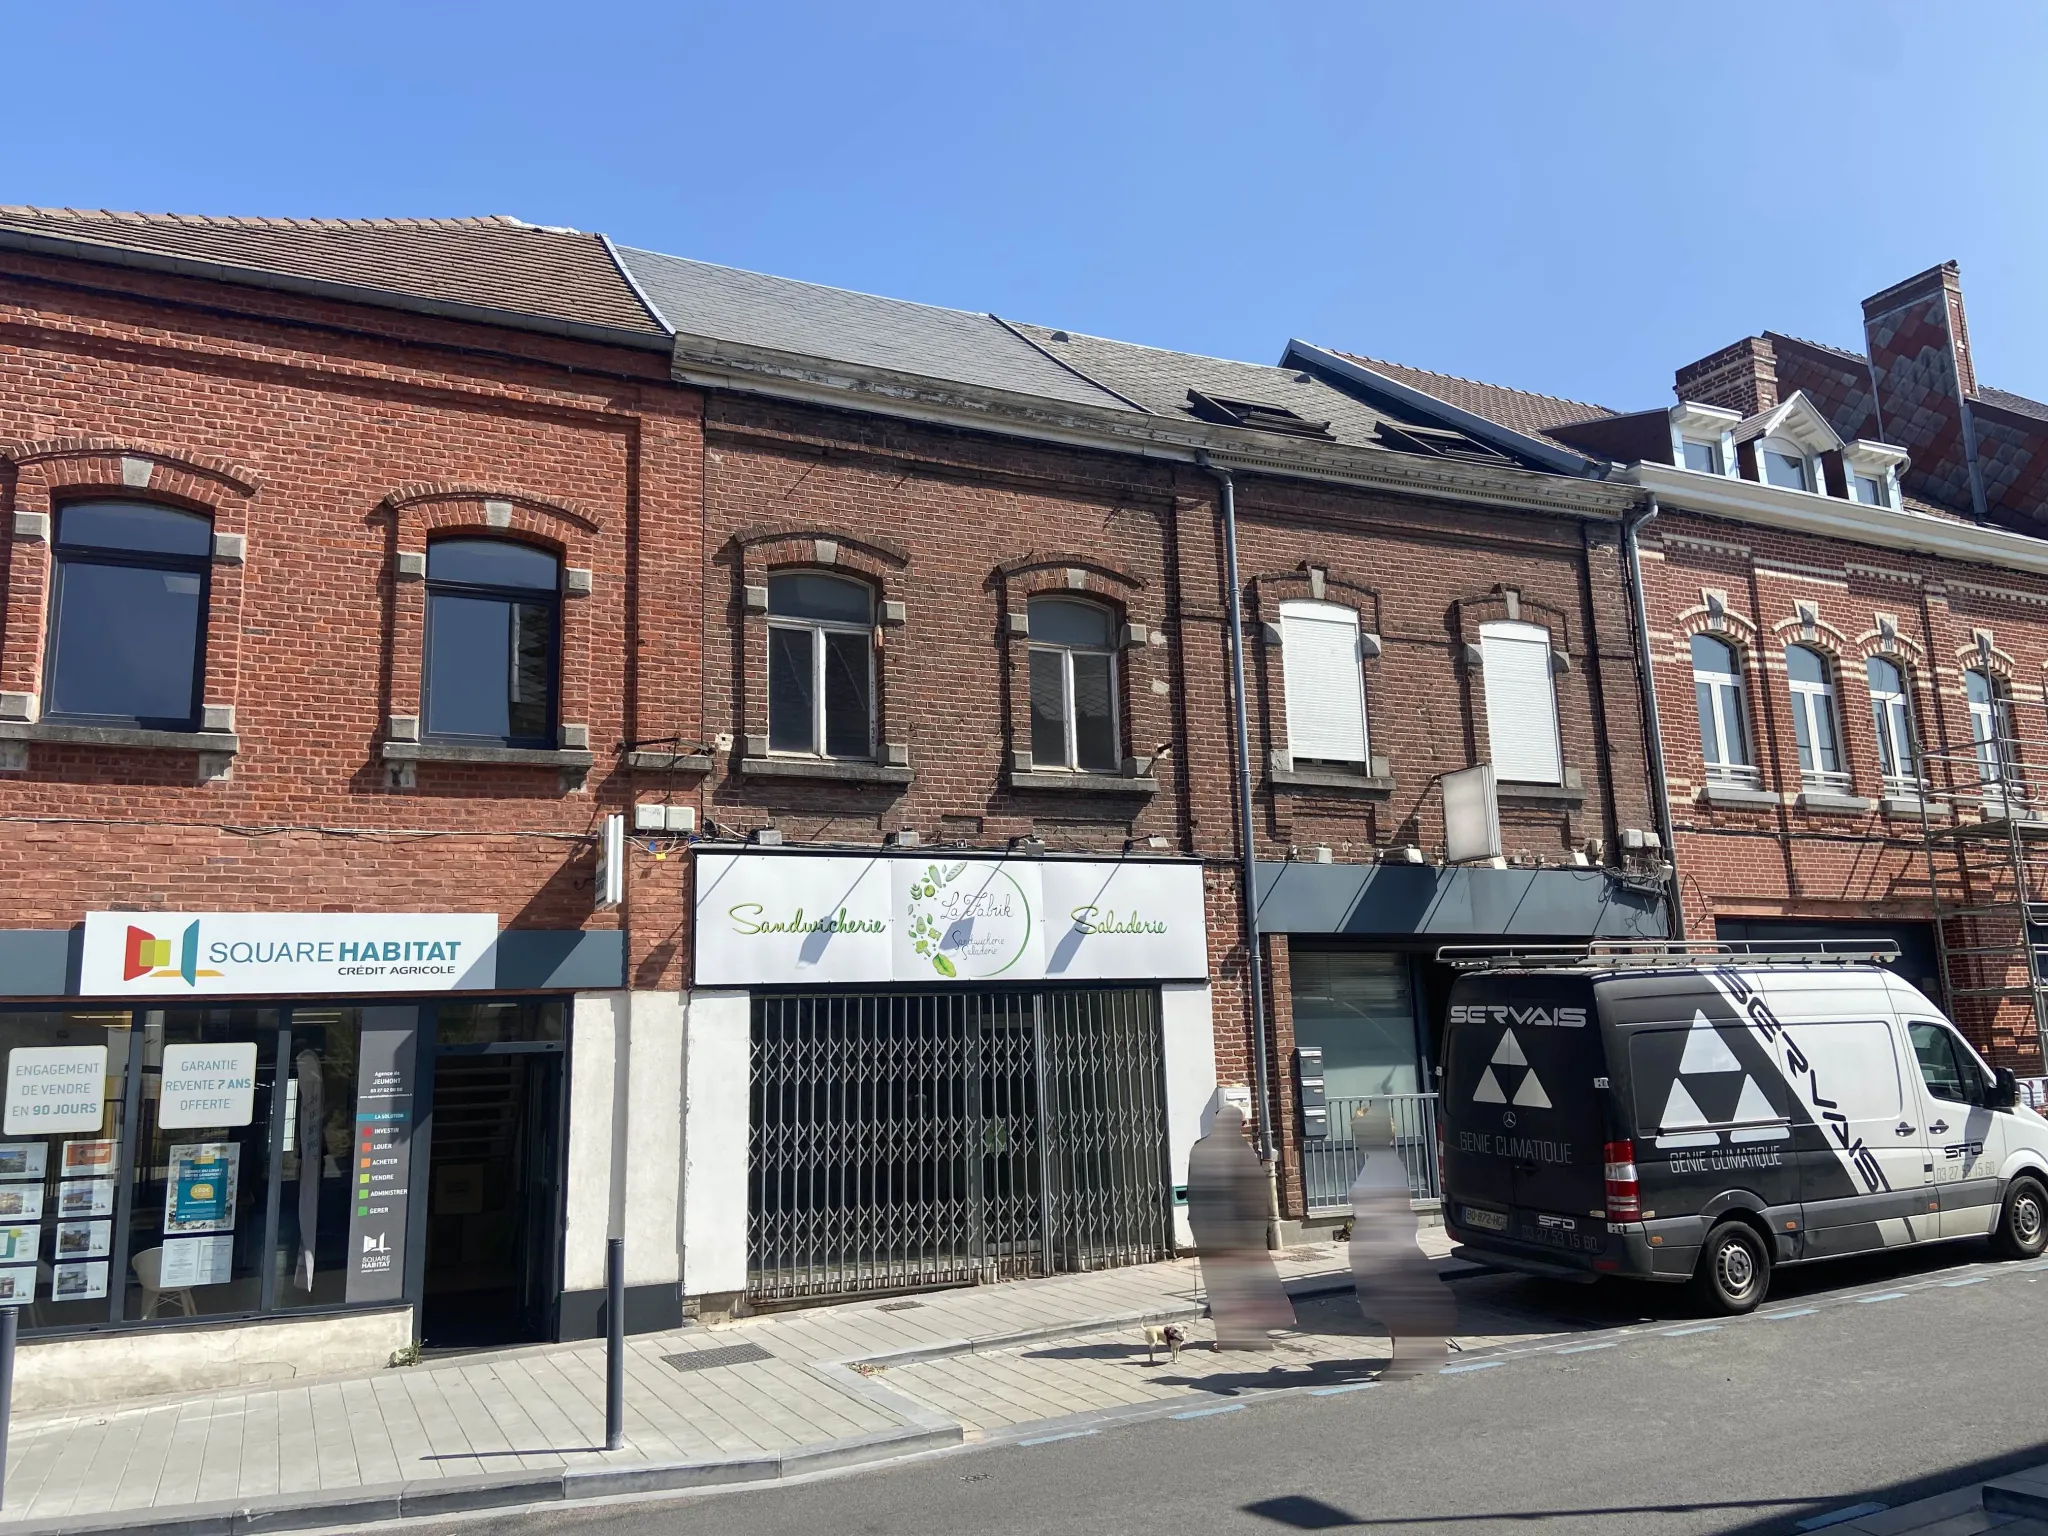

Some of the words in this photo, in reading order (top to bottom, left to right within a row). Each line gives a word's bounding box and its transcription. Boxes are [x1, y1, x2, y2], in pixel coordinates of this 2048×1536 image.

[940, 891, 960, 920] La
[964, 892, 1013, 918] Fabrik
[728, 902, 886, 935] Sandwicherie
[1070, 906, 1167, 935] Saladerie
[952, 930, 1004, 950] Sandwicherie
[961, 944, 998, 960] Saladerie
[338, 965, 386, 976] CRÉDIT
[389, 966, 455, 975] AGRICOLE
[1450, 1005, 1587, 1028] SERVAIS
[16, 1063, 100, 1076] ENGAGEMENT
[181, 1060, 238, 1072] GARANTIE
[165, 1080, 215, 1091] REVENTE
[217, 1079, 225, 1090] 7
[227, 1078, 251, 1089] ANS
[1713, 965, 1893, 1194] SERVAIS
[22, 1085, 38, 1096] DE
[41, 1083, 91, 1095] VENDRE
[12, 1106, 29, 1117] EN
[33, 1104, 50, 1116] 90
[53, 1103, 97, 1115] JOURS
[180, 1099, 231, 1111] OFFERTE
[1460, 1131, 1491, 1154] GENIE
[1495, 1135, 1573, 1164] CLIMATIQUE
[1670, 1150, 1708, 1173] GENIE
[1711, 1145, 1782, 1170] CLIMATIQUE
[1936, 1168, 1947, 1181] 03
[1949, 1166, 1958, 1179] 27
[1975, 1162, 1983, 1176] 15
[1985, 1161, 1995, 1175] 60
[370, 1189, 408, 1197] ADMINISTRER
[1536, 1227, 1548, 1241] 27
[1568, 1232, 1580, 1248] 15
[1584, 1235, 1597, 1250] 60
[361, 1261, 390, 1269] HABITAT
[362, 1255, 391, 1263] SQUARE
